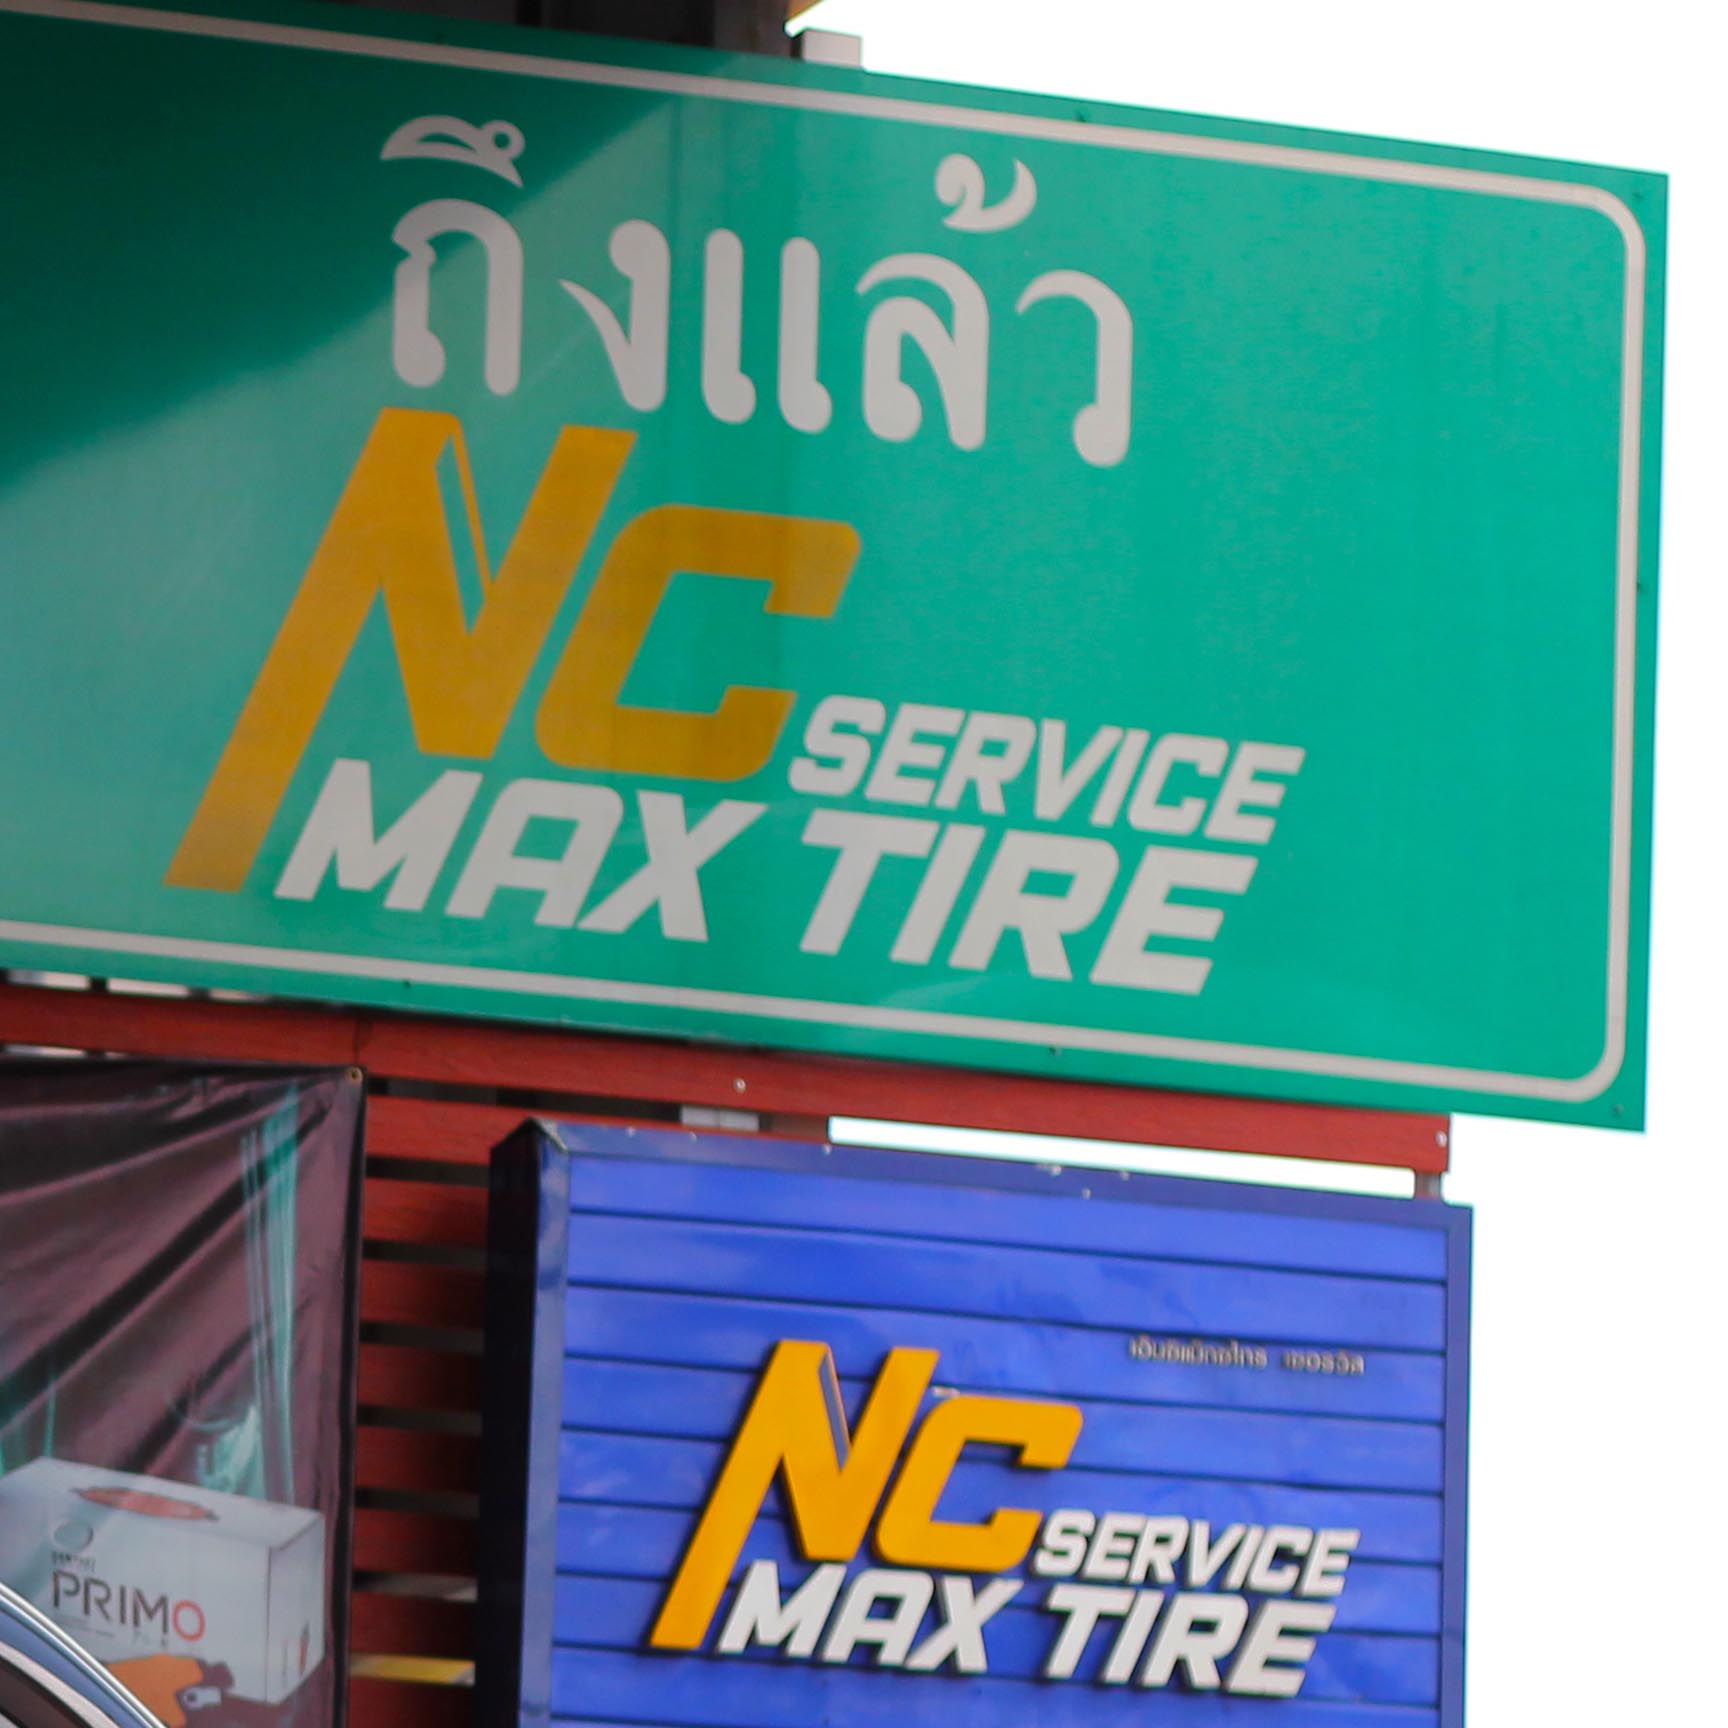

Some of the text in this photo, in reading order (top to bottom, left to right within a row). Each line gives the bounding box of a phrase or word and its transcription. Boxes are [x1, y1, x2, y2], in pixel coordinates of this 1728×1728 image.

[380, 114, 1135, 468] ถึงแล้ว
[161, 406, 862, 892] NC
[787, 695, 1306, 846] SERVICE
[274, 757, 1259, 996] MAX TIRE
[647, 1338, 1083, 1651] NC
[1032, 1508, 1361, 1599] SERVICE
[52, 1569, 207, 1643] PRIMO
[717, 1559, 1337, 1700] MAX TIRE
